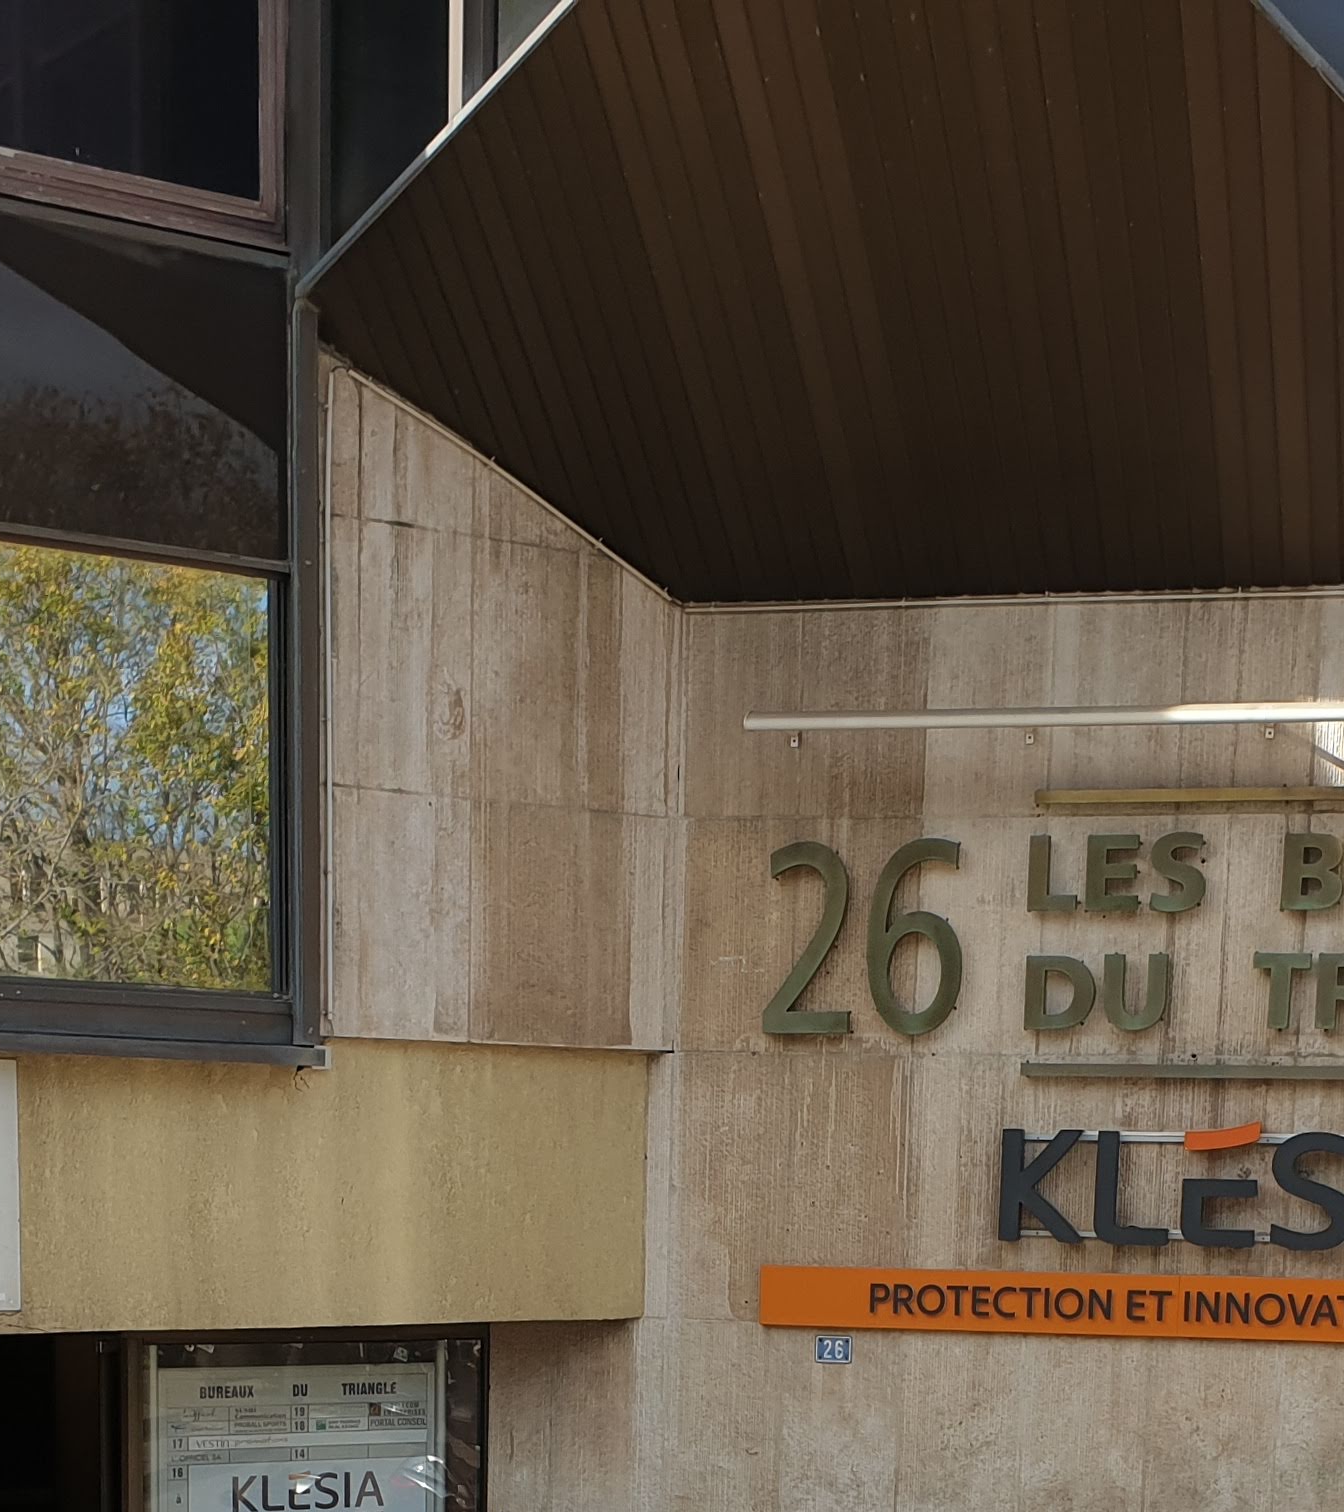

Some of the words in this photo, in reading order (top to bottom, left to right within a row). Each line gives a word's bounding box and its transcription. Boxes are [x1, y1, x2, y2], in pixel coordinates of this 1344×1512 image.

[762, 837, 962, 1036] 26
[1026, 831, 1208, 913] LES
[1023, 951, 1173, 1032] DU
[868, 1282, 1113, 1322] PROTECTION
[1125, 1288, 1173, 1323] ET
[822, 1339, 845, 1360] 26
[199, 1385, 254, 1399] BUREAUX
[292, 1383, 308, 1397] DU
[341, 1381, 397, 1396] TRIANGLE
[294, 1406, 305, 1417] 19
[294, 1420, 305, 1431] 18
[172, 1438, 183, 1449] 17
[294, 1448, 305, 1459] 14
